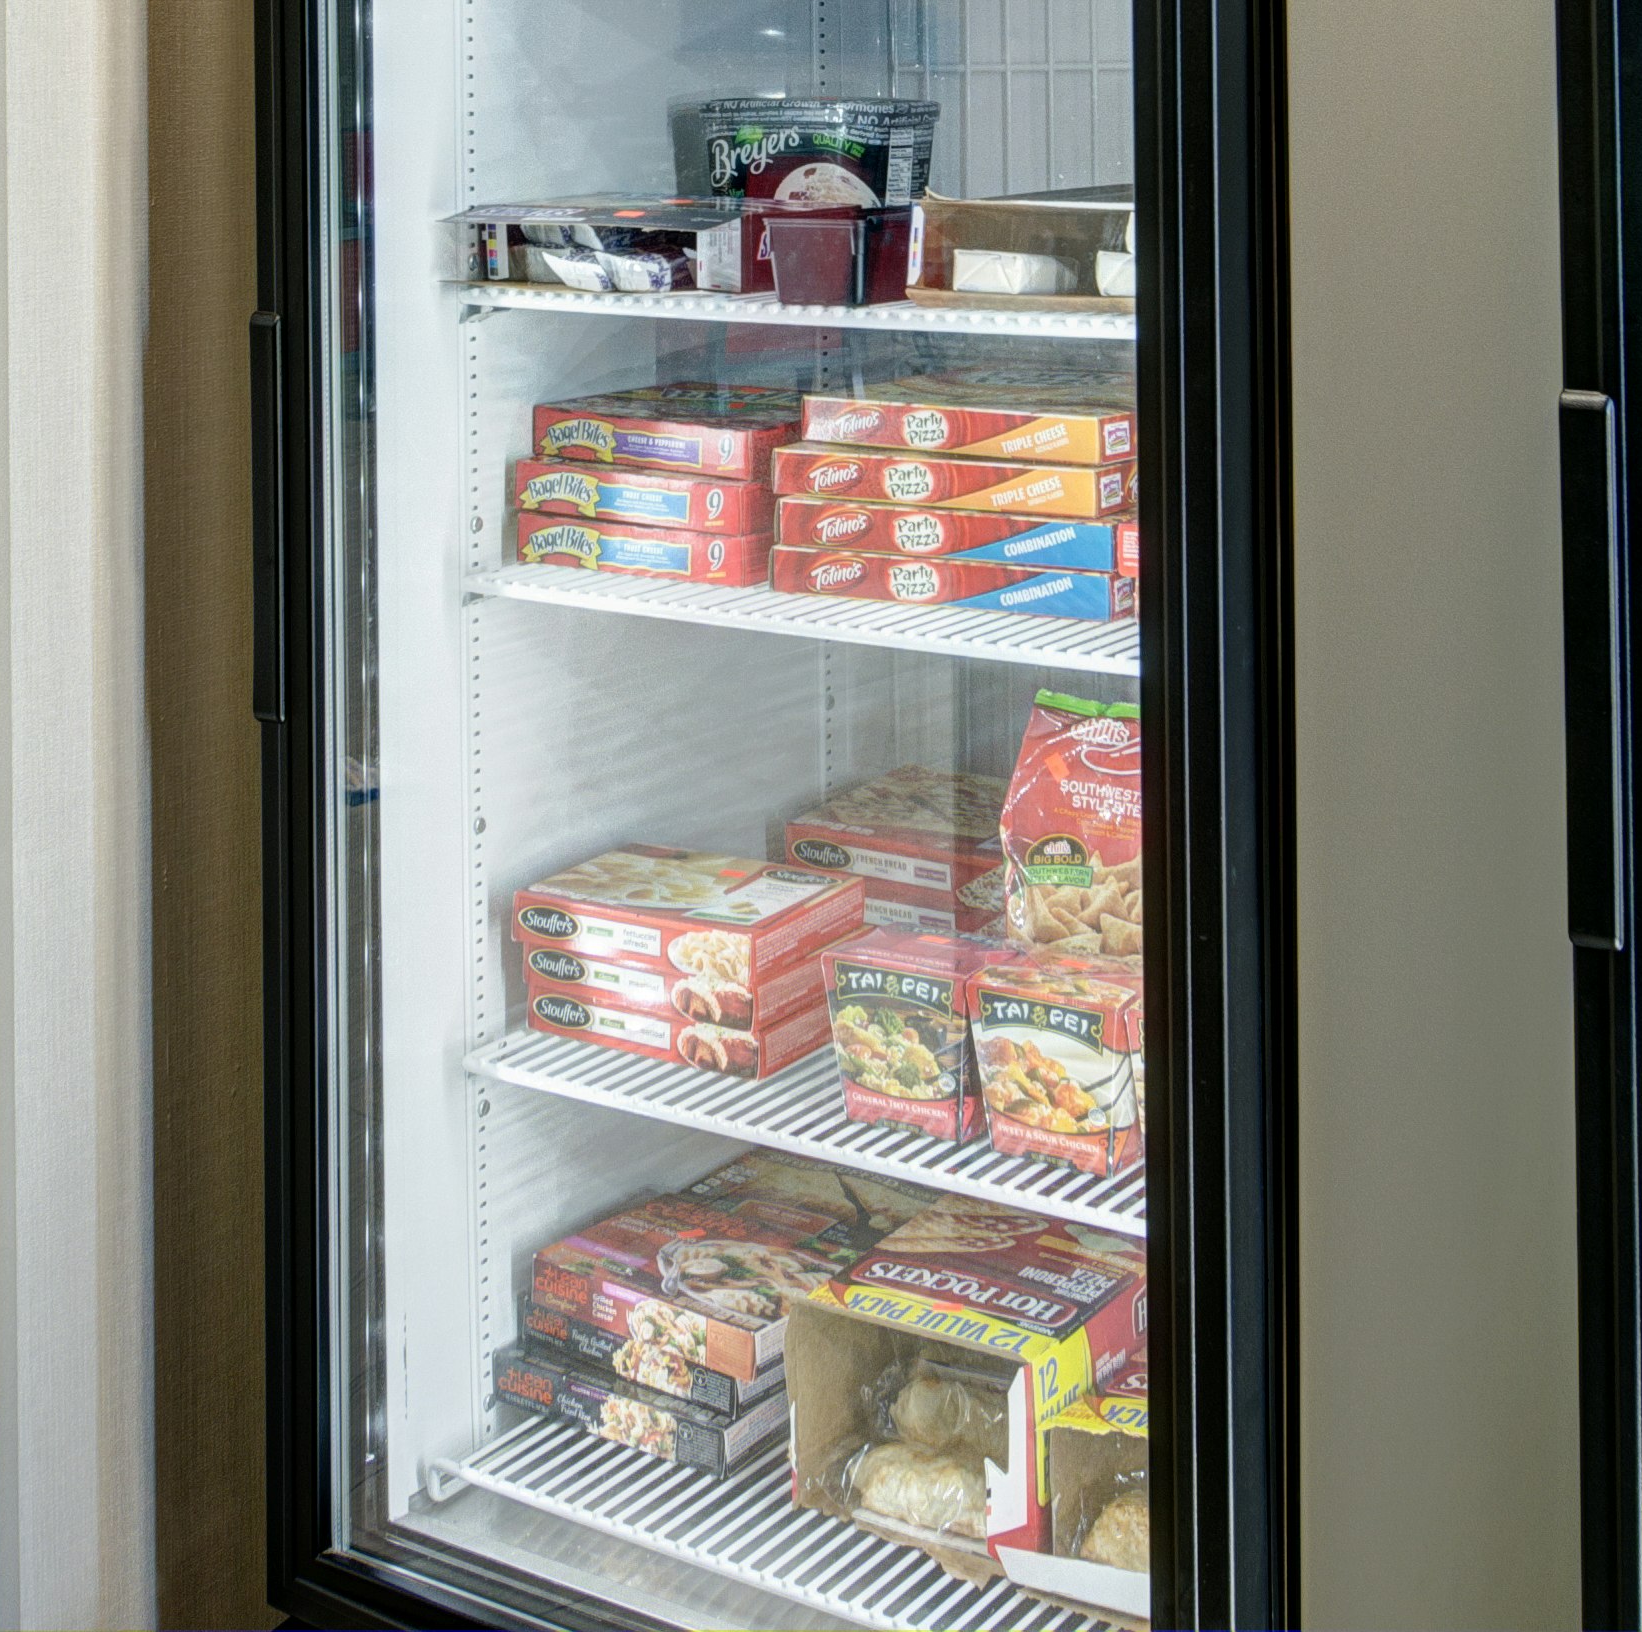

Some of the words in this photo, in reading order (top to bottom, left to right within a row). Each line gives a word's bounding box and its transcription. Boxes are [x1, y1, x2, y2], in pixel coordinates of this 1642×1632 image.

[711, 125, 800, 187] Breyers
[834, 411, 880, 438] Totino's
[907, 411, 943, 428] Party
[547, 423, 581, 447] Bagel
[581, 421, 609, 450] Bites
[718, 434, 735, 464] 9
[909, 428, 946, 444] Pizza
[1000, 435, 1034, 454] TRIPLE
[1033, 423, 1068, 445] CHEESE
[809, 463, 860, 492] Totino's
[887, 463, 927, 482] Party
[528, 474, 563, 499] Bagel
[563, 474, 594, 503] Bites
[890, 480, 930, 498] Pizza
[990, 487, 1026, 507] TRIPLE
[1026, 475, 1063, 498] CHEESE
[707, 489, 723, 519] 9
[816, 513, 869, 543] Totino's
[896, 516, 938, 533] Party
[529, 527, 565, 553] Bagel
[565, 526, 596, 557] Bites
[898, 532, 940, 549] Pizza
[1003, 526, 1077, 557] COMBINATION
[709, 541, 724, 571] 9
[810, 562, 863, 590] Totino's
[891, 564, 933, 581] Party
[894, 580, 936, 598] Pizza
[999, 576, 1074, 606] COMBINATION
[800, 842, 847, 866] Stouffer's
[1033, 855, 1051, 865] BIG
[1056, 854, 1083, 865] BOLD
[526, 909, 574, 935] Stouffer's
[535, 953, 581, 978] Stouffer's
[848, 971, 883, 990] TAI
[901, 977, 940, 1003] PEI
[540, 998, 586, 1024] Stouffer's
[993, 1001, 1030, 1019] TAI
[1049, 1009, 1090, 1036] PEI
[862, 1259, 997, 1305] POCKETS
[846, 1292, 913, 1320] PACK
[994, 1287, 1065, 1321] HOT
[914, 1305, 988, 1342] VALUE
[987, 1327, 1031, 1354] 12
[497, 1376, 554, 1407] cuisine
[1039, 1356, 1059, 1408] 12
